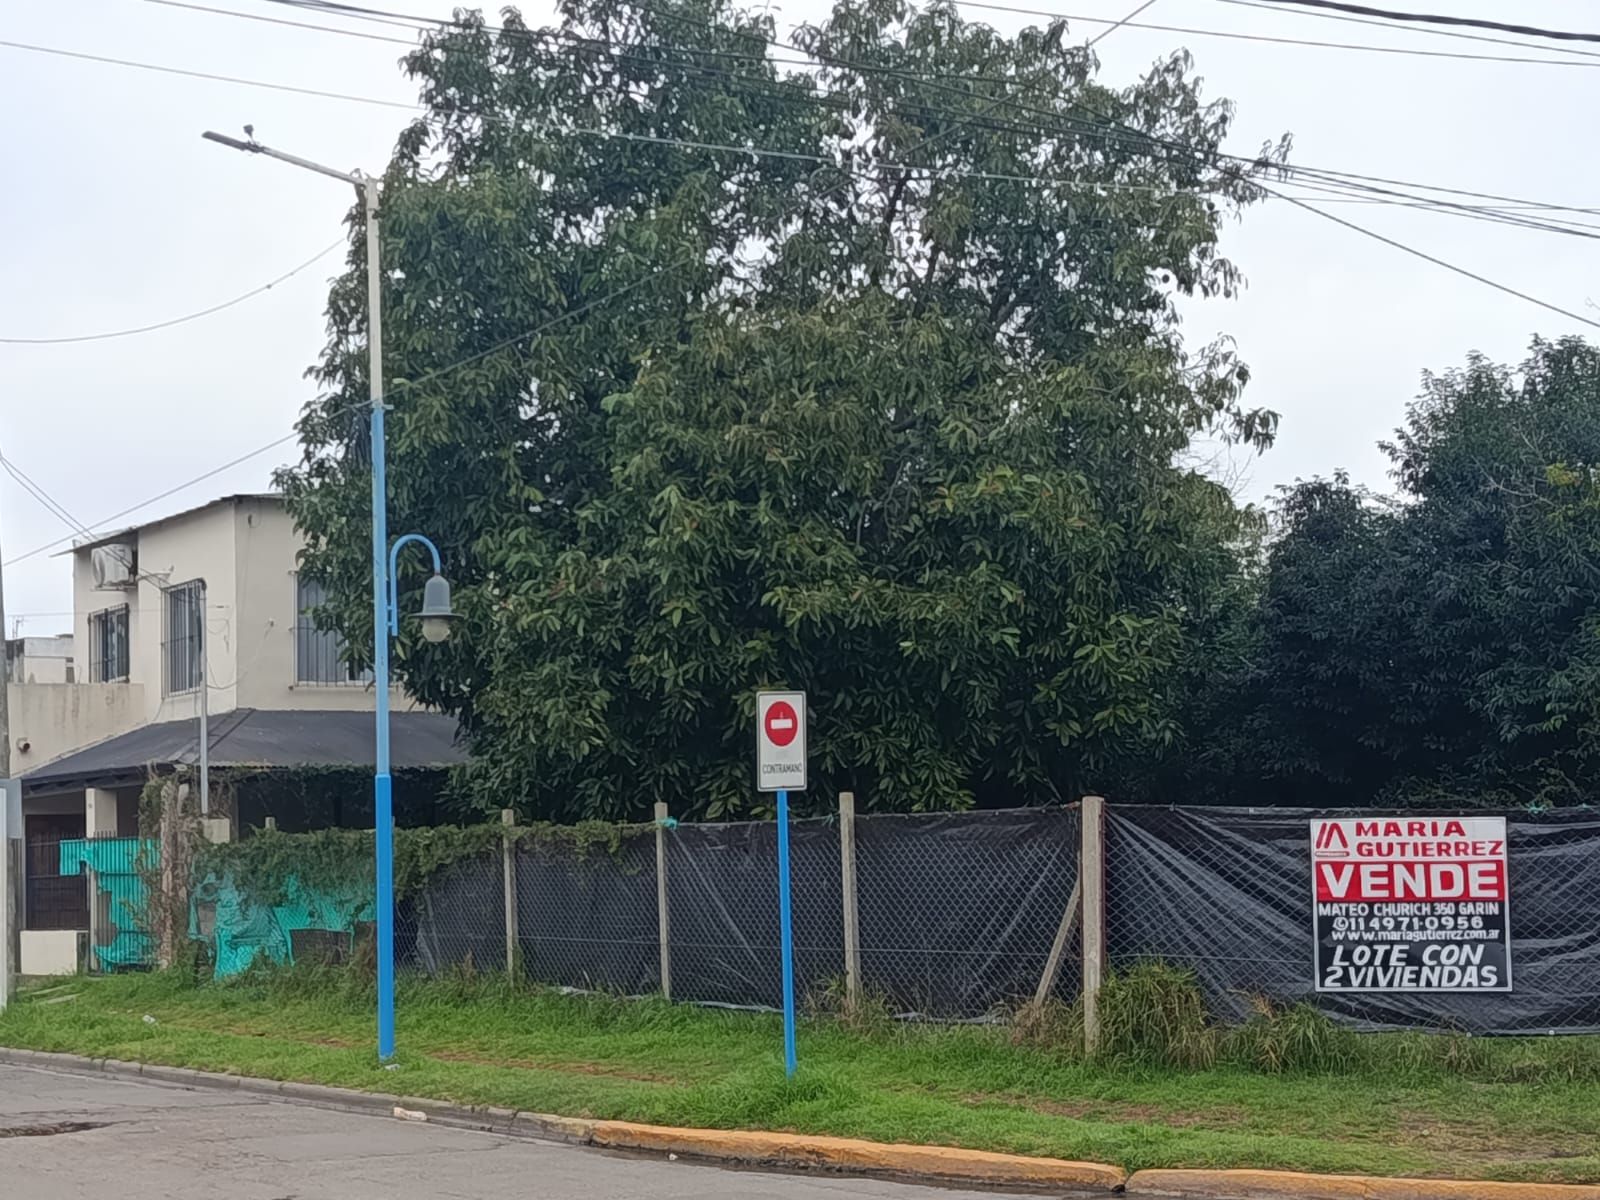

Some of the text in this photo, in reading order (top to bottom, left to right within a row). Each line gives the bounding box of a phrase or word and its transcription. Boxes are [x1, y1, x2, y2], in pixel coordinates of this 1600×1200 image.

[1355, 821, 1466, 837] MARIA
[1356, 840, 1504, 857] GUTIERREZ
[1321, 863, 1499, 898] VENDE
[1318, 904, 1369, 916] MATEO
[1373, 903, 1431, 916] CHURICH
[1458, 902, 1499, 915] GARIN
[1332, 929, 1500, 942] www.mariagutierrez.com.ar
[1332, 944, 1485, 967] LOTE CON
